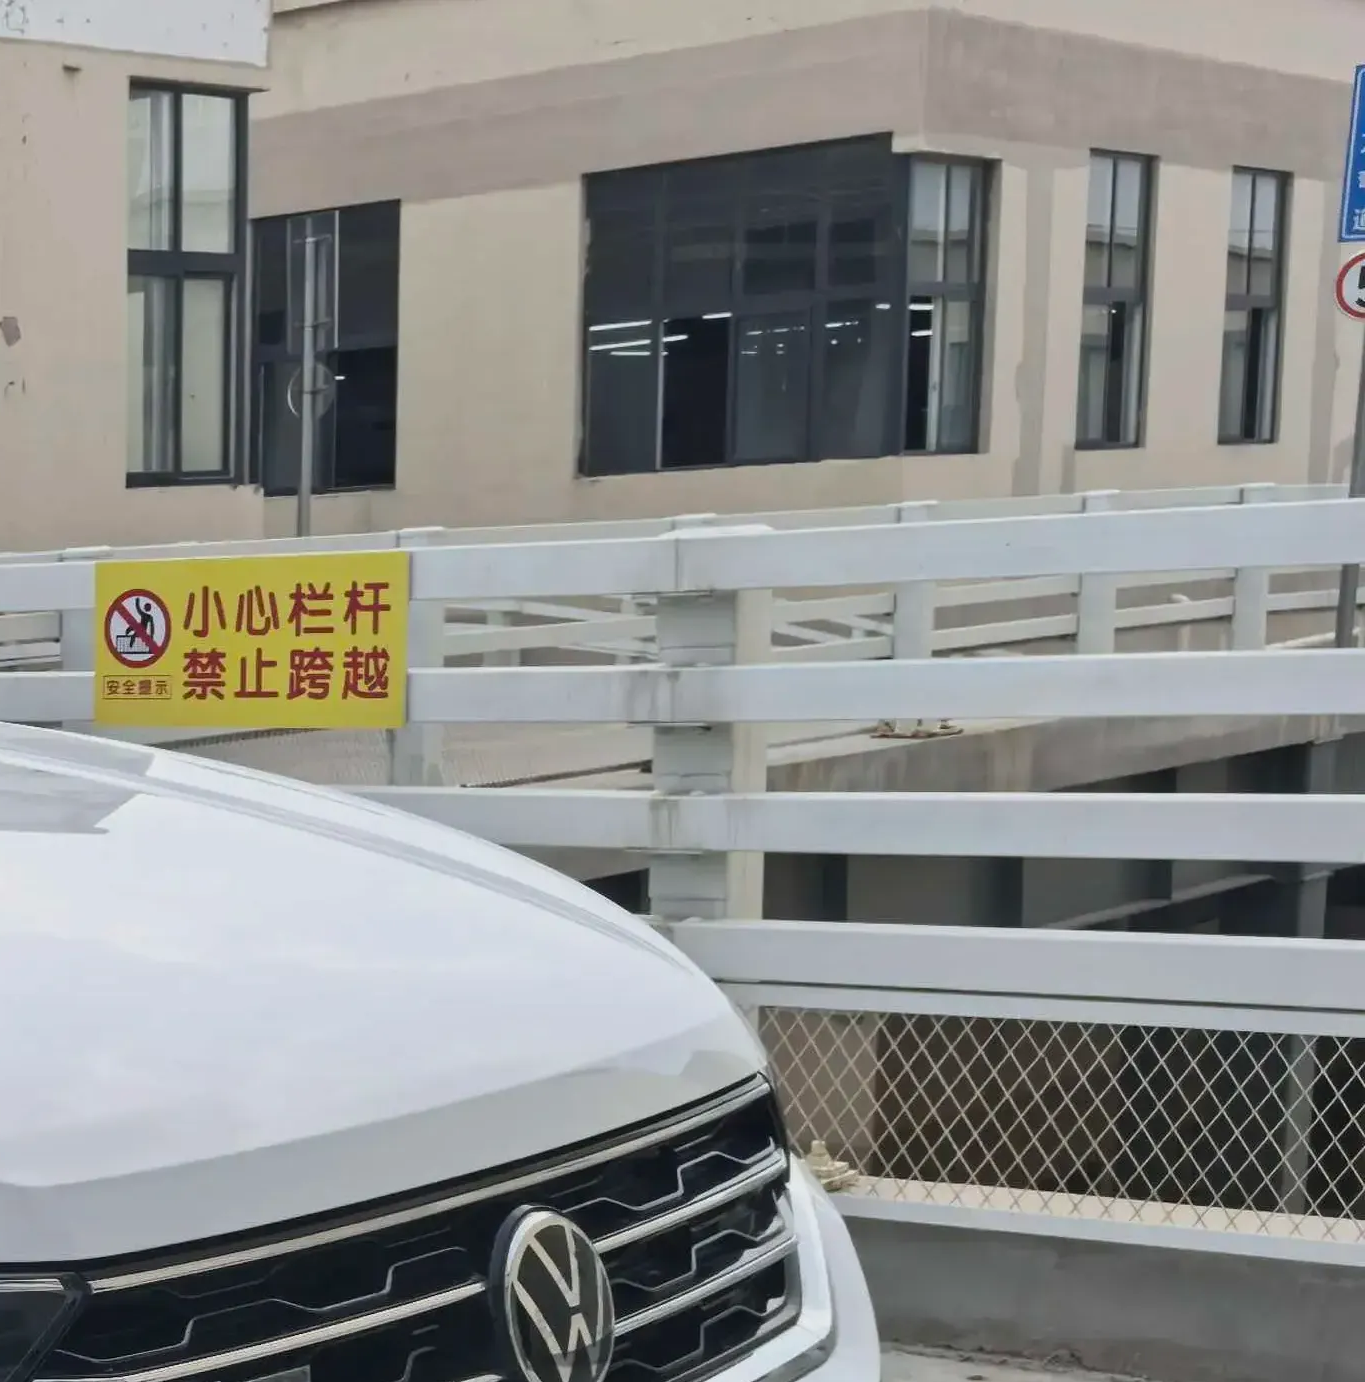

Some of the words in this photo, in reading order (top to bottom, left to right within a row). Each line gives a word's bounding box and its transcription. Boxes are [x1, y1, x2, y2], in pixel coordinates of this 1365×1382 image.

[182, 580, 392, 638] 小心栏杆
[181, 647, 391, 701] 禁止跨越
